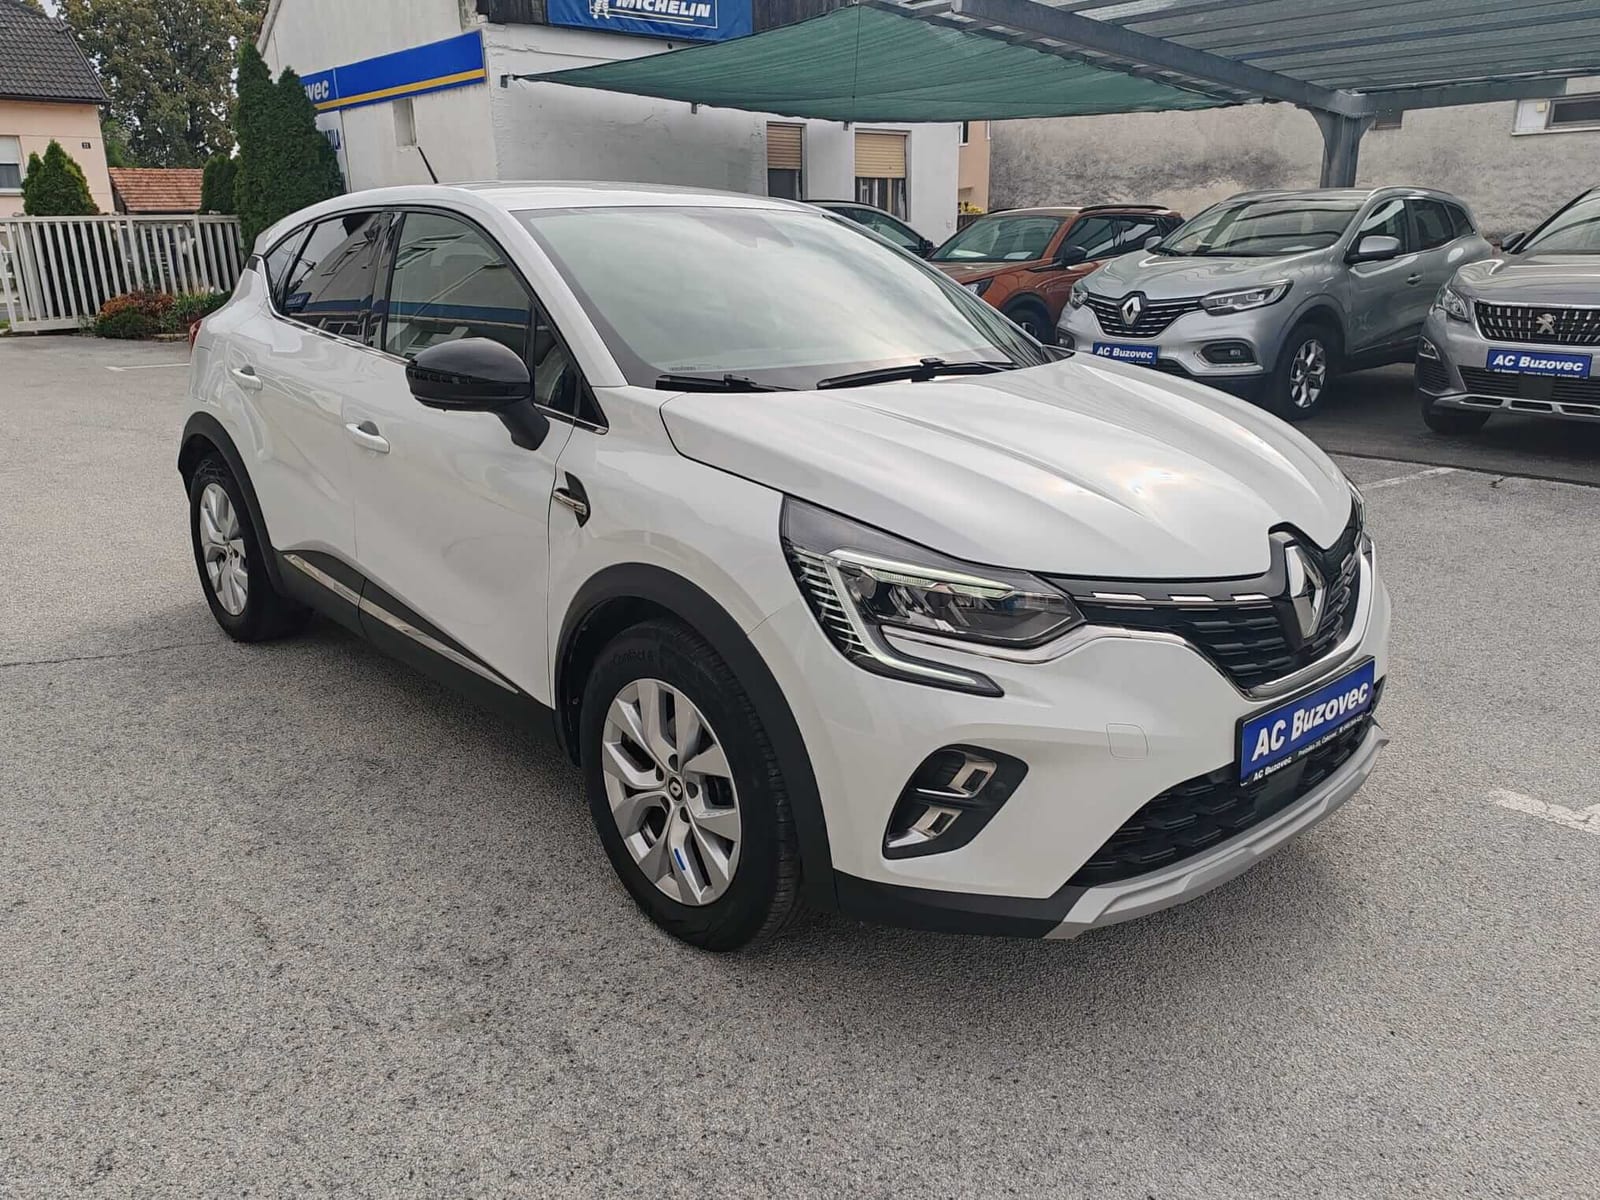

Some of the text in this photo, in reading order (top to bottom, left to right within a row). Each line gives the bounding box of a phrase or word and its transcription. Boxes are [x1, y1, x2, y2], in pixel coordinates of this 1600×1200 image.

[615, 0, 711, 18] MICHELIN
[1096, 346, 1154, 359] AC Buzovec
[1492, 354, 1584, 372] AC Buzovec
[1251, 719, 1287, 762] AC
[1290, 682, 1369, 742] Buzovec
[1253, 769, 1264, 782] AC
